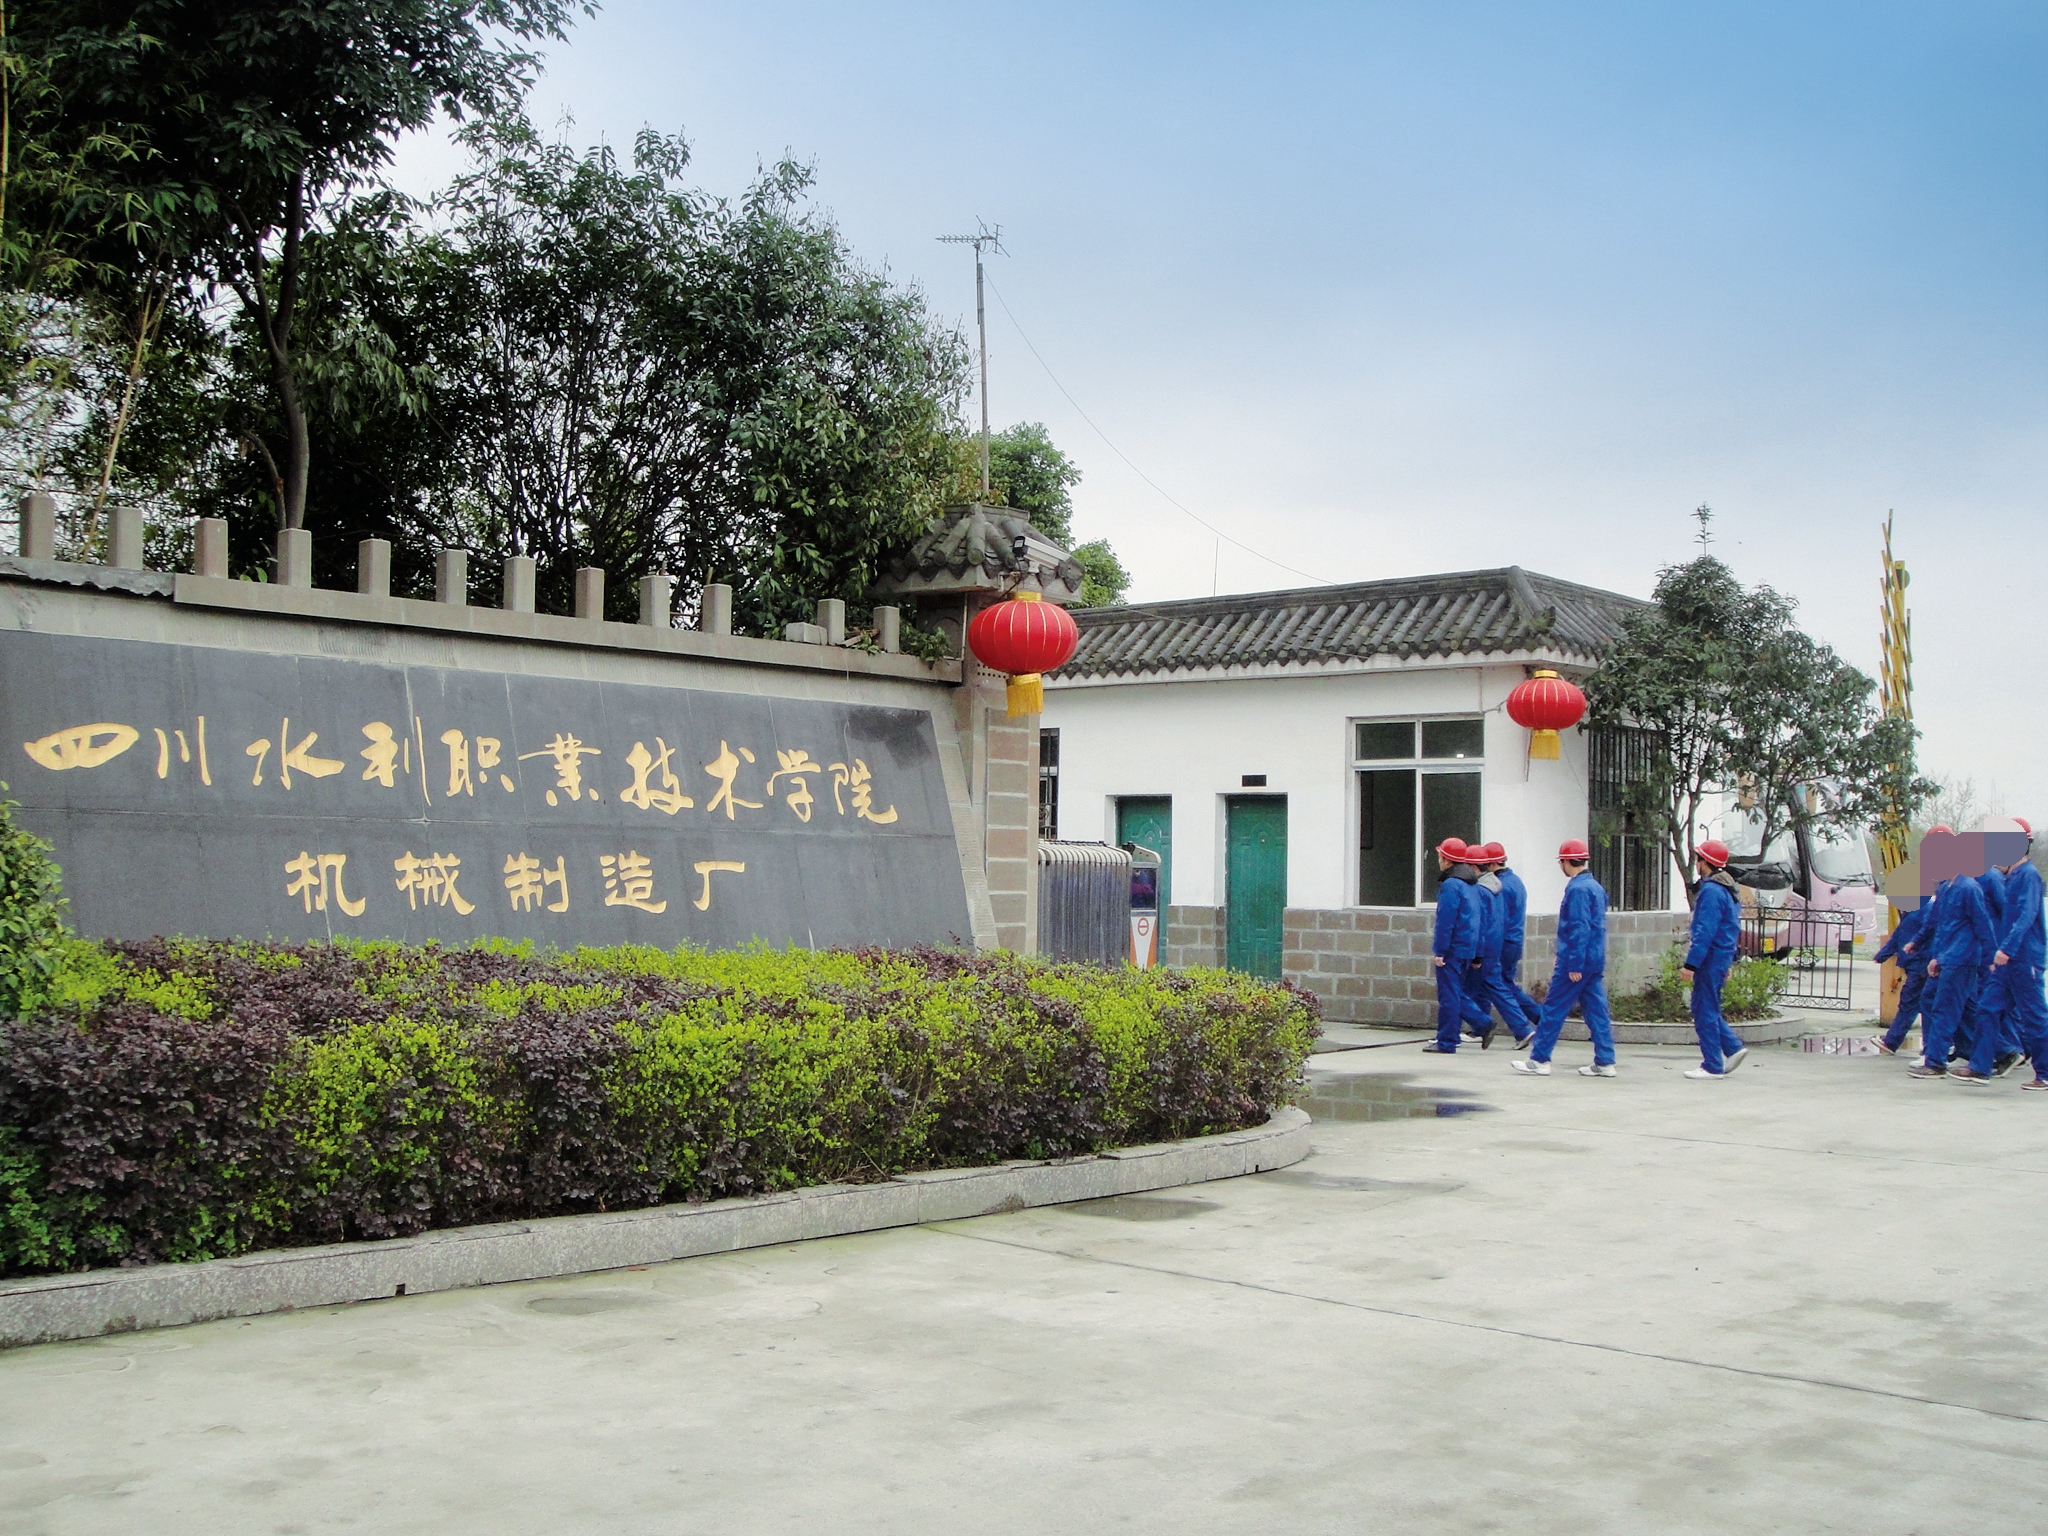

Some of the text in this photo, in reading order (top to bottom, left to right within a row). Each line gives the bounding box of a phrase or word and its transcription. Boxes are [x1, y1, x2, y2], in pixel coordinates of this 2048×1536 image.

[285, 850, 746, 917] 机械制造厂
